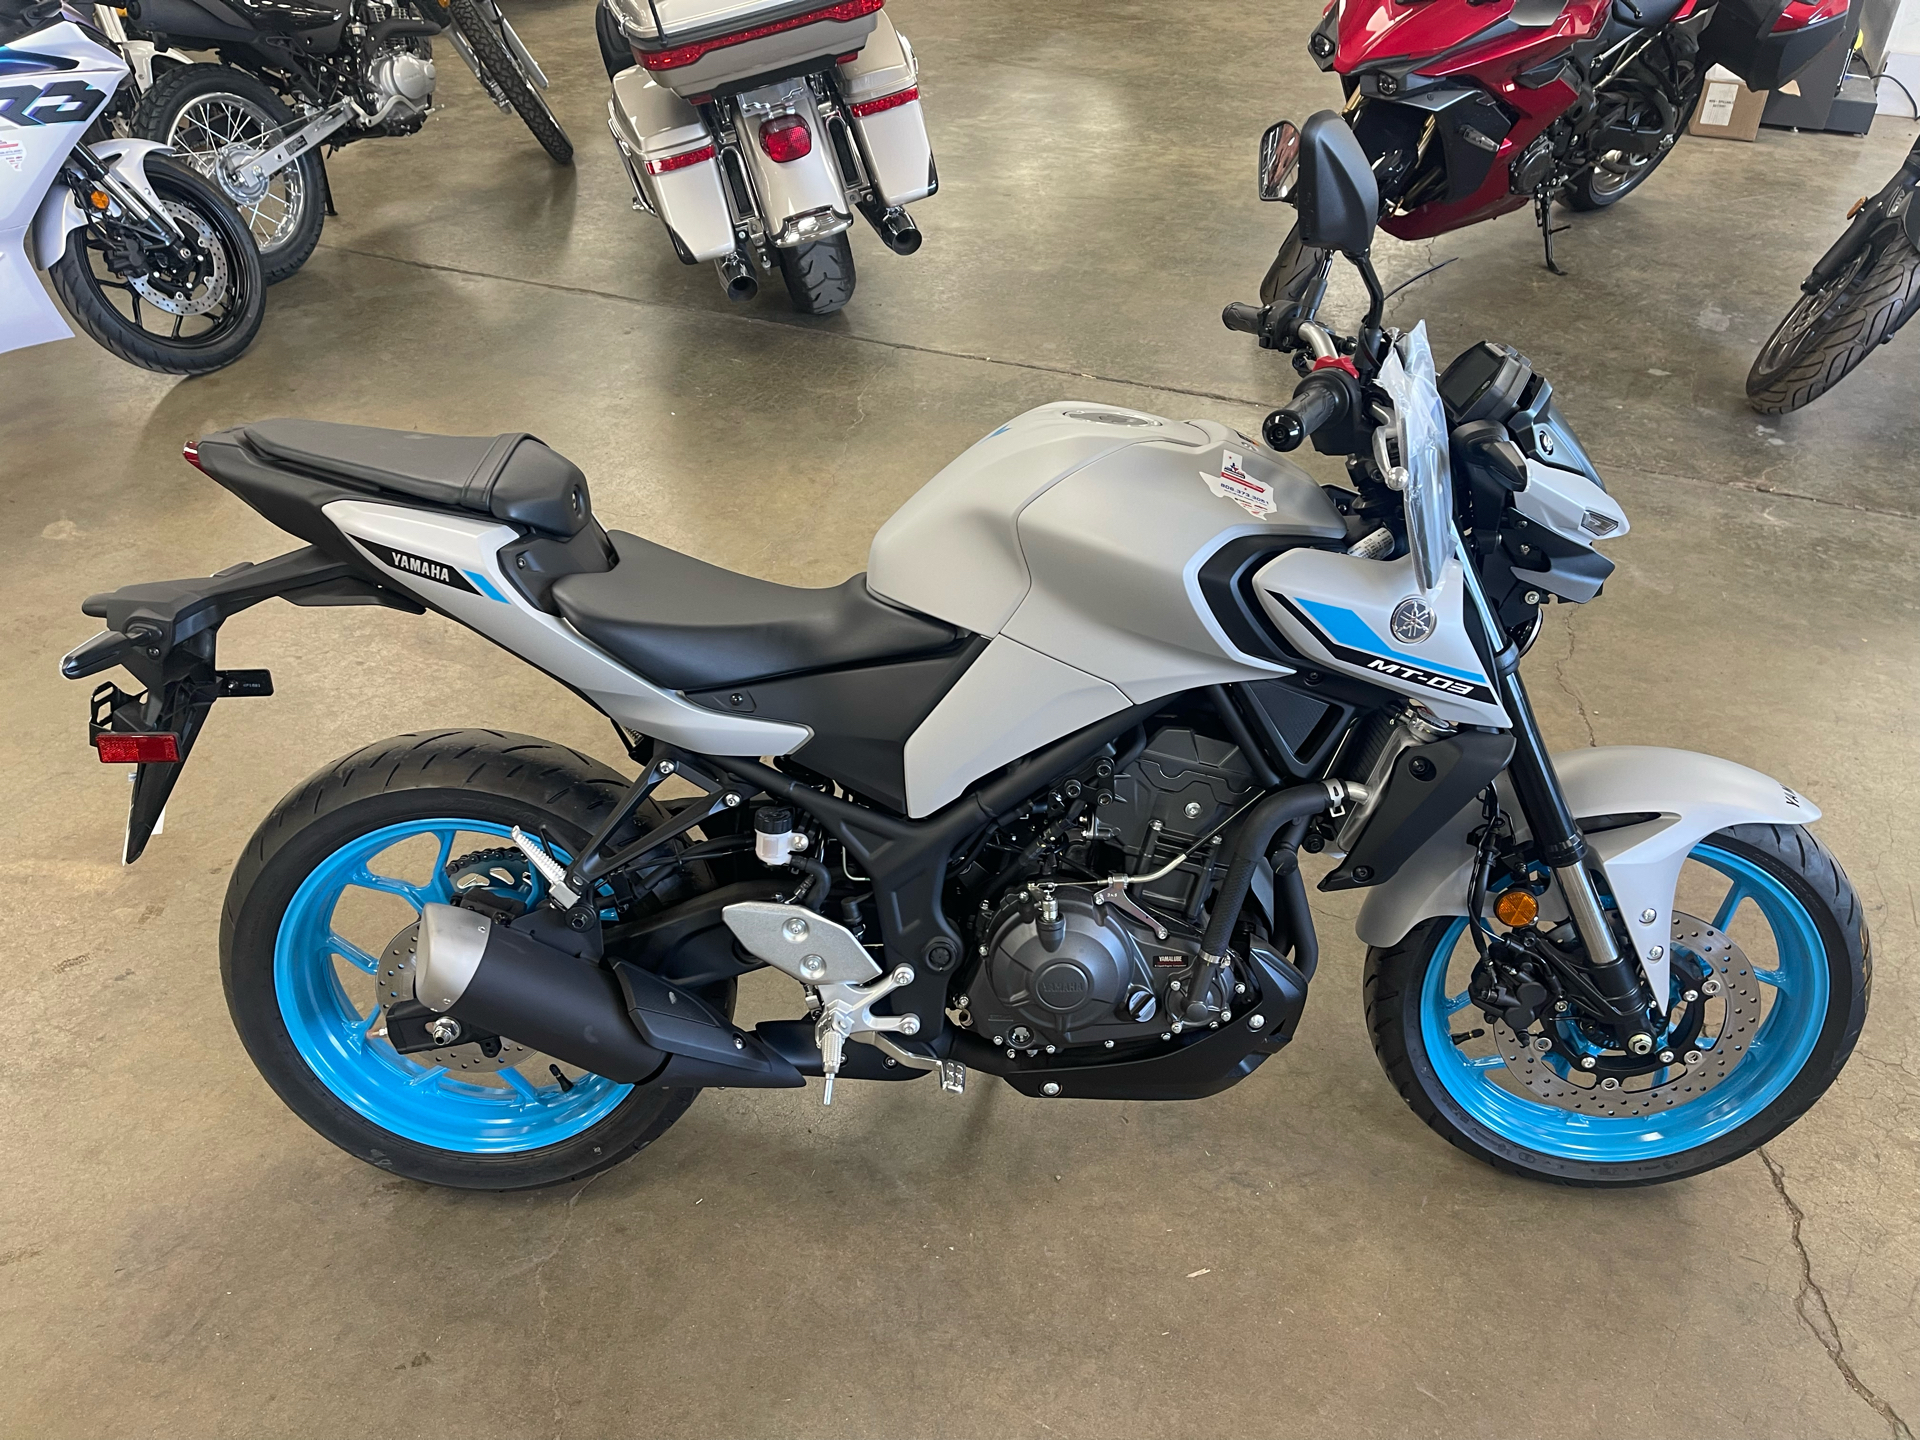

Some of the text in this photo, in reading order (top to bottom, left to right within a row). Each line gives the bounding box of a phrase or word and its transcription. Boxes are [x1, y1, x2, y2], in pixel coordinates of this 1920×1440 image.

[391, 551, 450, 582] YAMAHA
[1367, 659, 1475, 695] MT-03
[1042, 982, 1084, 993] YAMAHA
